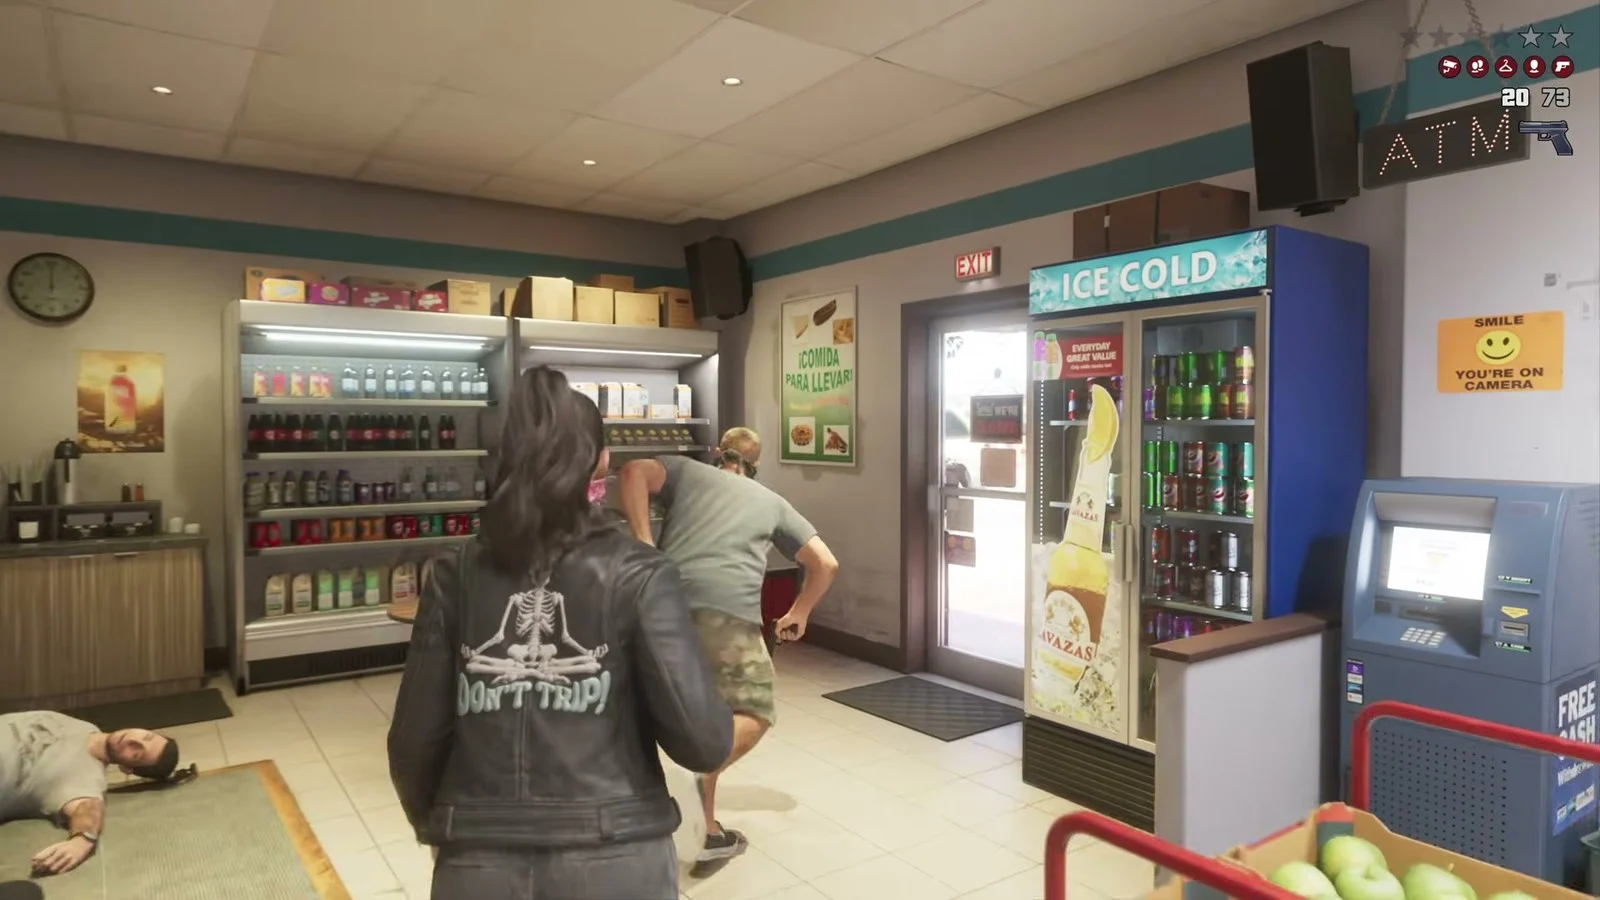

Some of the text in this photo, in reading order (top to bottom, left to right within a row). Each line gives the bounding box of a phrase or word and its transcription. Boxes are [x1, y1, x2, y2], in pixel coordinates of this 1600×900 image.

[1379, 109, 1510, 175] ATM
[956, 250, 991, 278] EXIT
[1063, 249, 1218, 301] ICE COLD
[1475, 315, 1524, 328] SMILE
[1066, 351, 1116, 363] GREAT VALUE
[1072, 341, 1111, 353] EVERYDAY
[799, 347, 840, 370] ¡COMIDA
[786, 374, 810, 393] PARA
[1456, 367, 1544, 380] YOU'RE ON
[1465, 380, 1533, 391] CAMERA
[457, 670, 611, 716] DON'T TRIP!
[1558, 680, 1597, 728] FREE
